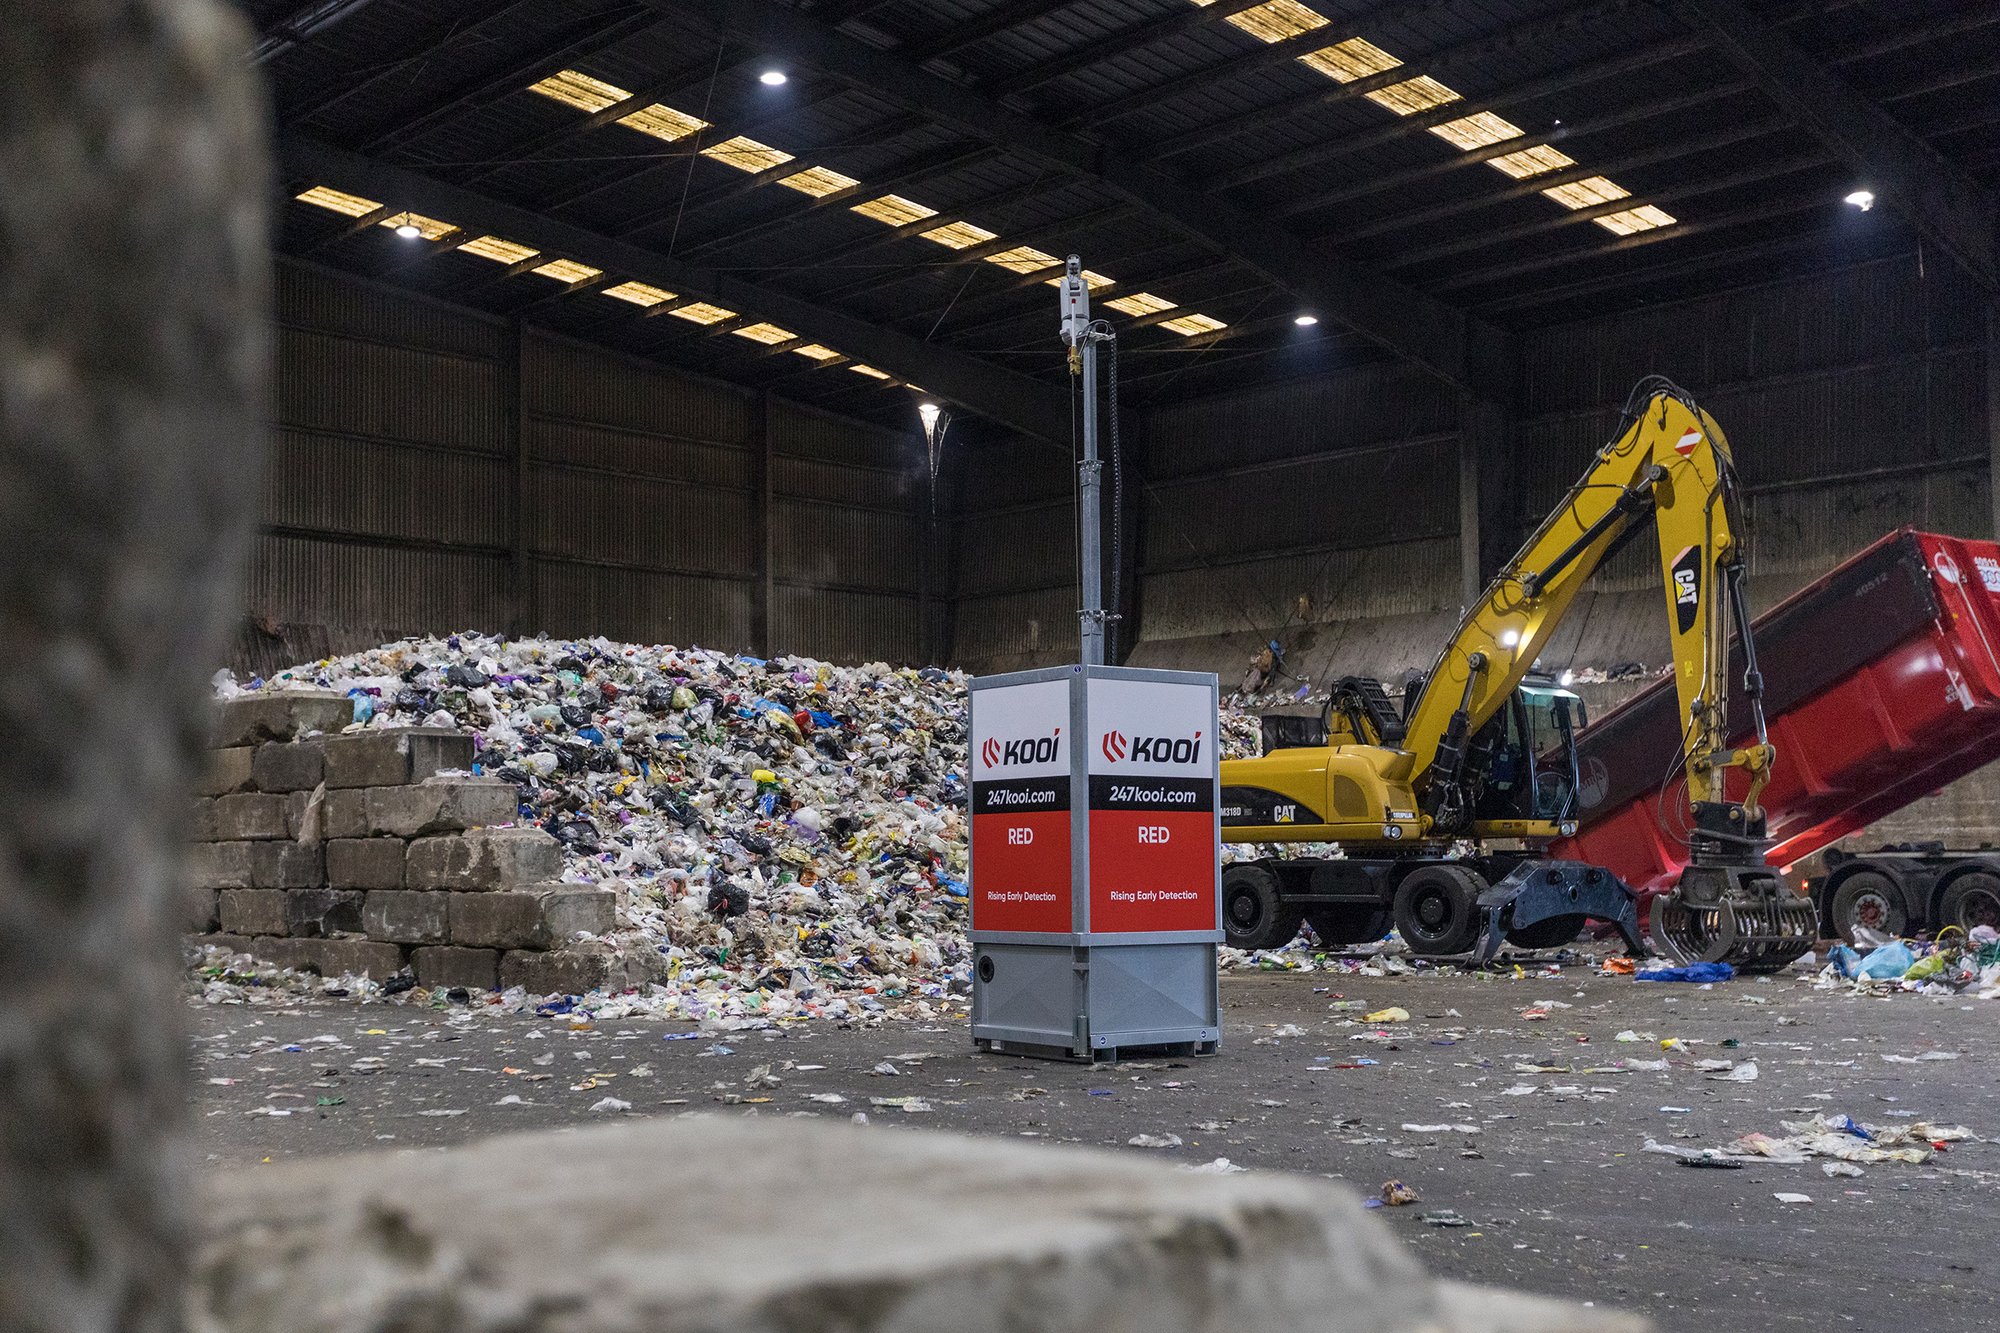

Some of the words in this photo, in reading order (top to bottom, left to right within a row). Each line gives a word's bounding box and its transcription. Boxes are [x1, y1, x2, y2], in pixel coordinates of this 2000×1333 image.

[1674, 569, 1697, 604] CAT
[987, 788, 1055, 805] 247kooi.com
[1109, 786, 1196, 803] 247kooi.com
[1274, 805, 1296, 822] CAT
[1008, 828, 1033, 844] RED
[1138, 827, 1170, 843] RED
[988, 892, 1006, 902] Rising
[1007, 892, 1023, 902] Early
[1023, 892, 1056, 901] Detection
[1110, 891, 1135, 901] Rising
[1137, 891, 1157, 901] Early
[1159, 890, 1198, 900] Detection
